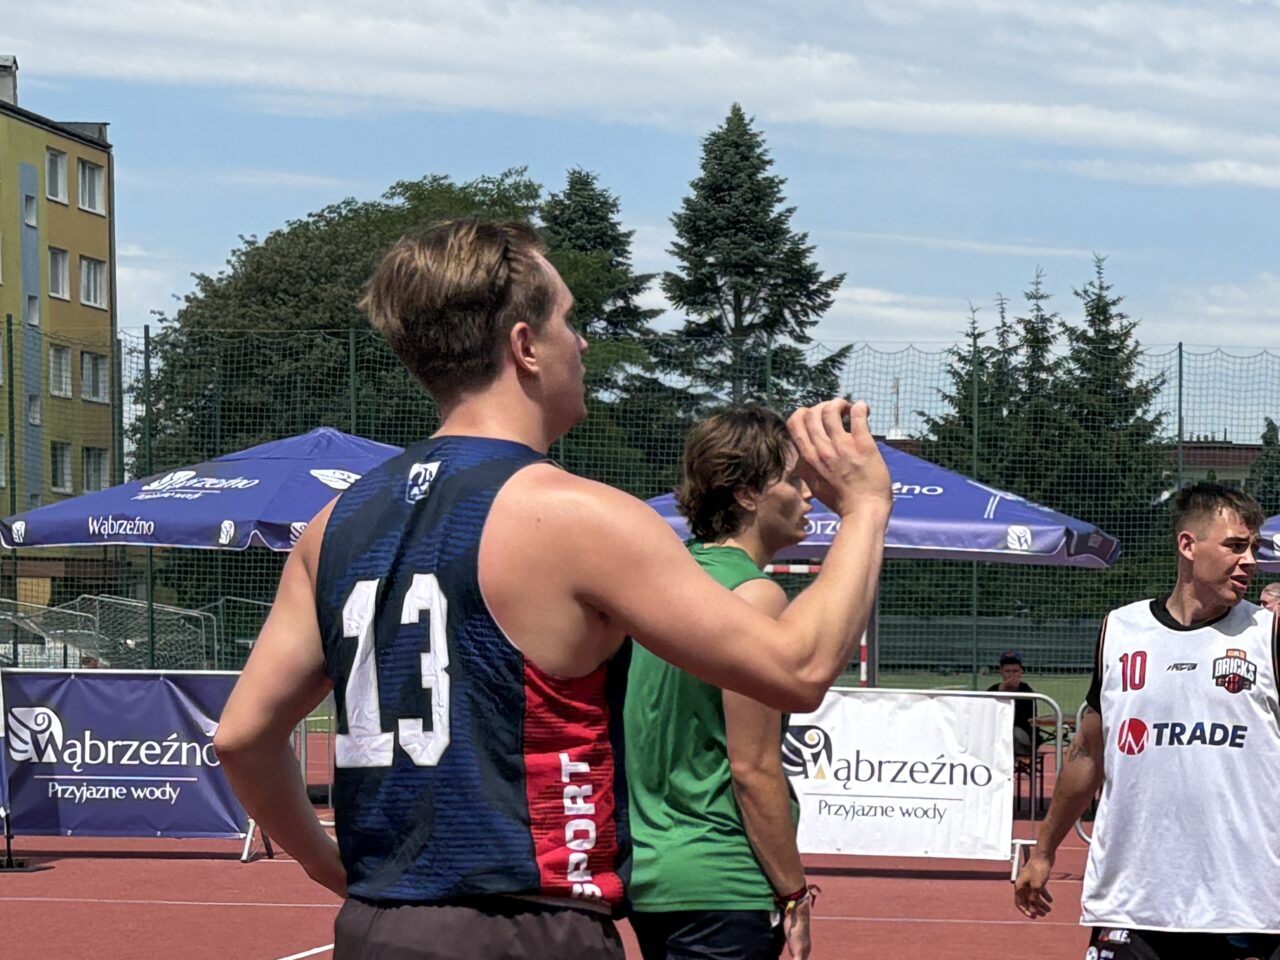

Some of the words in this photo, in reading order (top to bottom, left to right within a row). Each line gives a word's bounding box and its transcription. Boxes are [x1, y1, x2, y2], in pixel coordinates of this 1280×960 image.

[88, 515, 155, 539] Wąbrzeźno
[335, 573, 450, 769] 13
[1119, 650, 1147, 692] 10
[1152, 721, 1248, 749] TRADE
[48, 782, 126, 803] Przyjazne
[130, 783, 180, 805] wody
[818, 799, 895, 821] Przyjazne
[899, 803, 947, 824] wody
